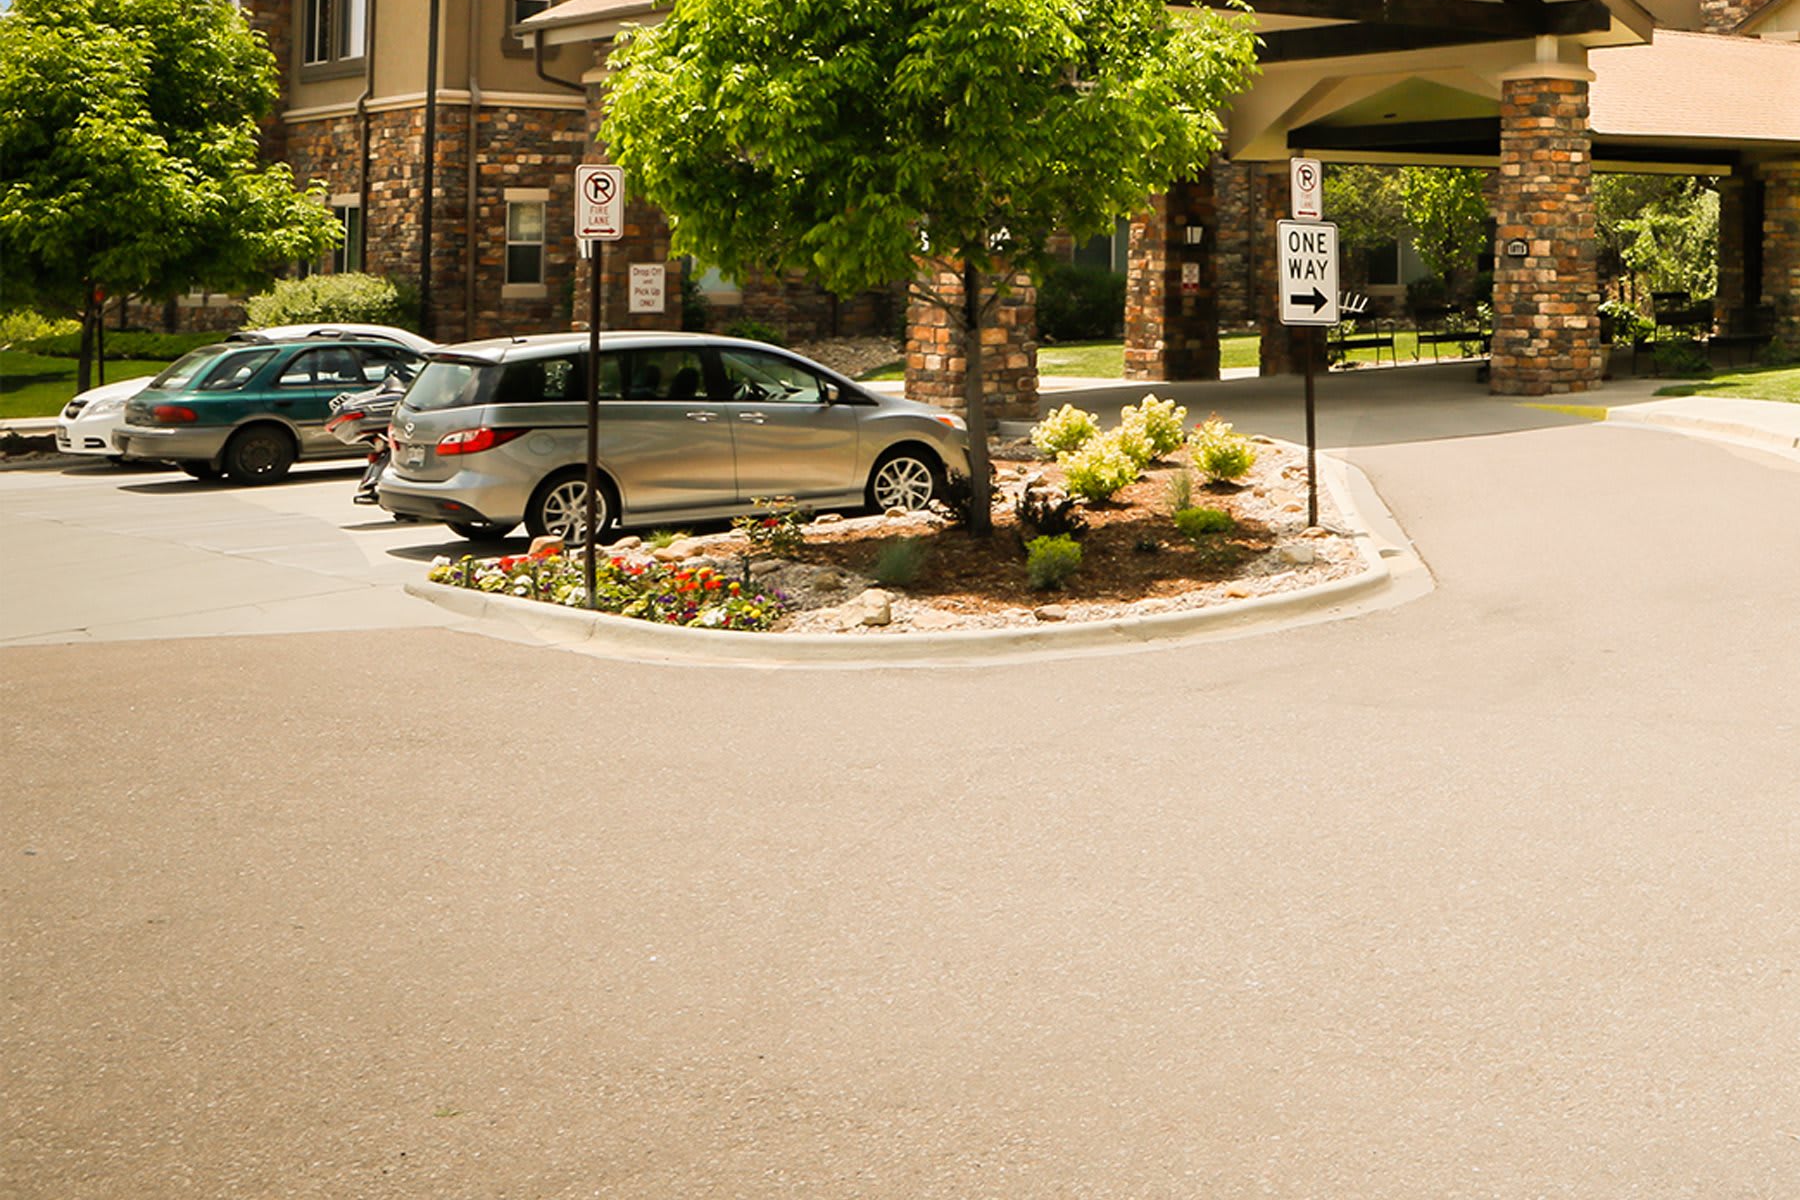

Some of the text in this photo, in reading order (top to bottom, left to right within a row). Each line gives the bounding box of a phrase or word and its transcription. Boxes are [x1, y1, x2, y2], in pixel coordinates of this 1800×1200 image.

[589, 206, 609, 215] FIRE
[588, 216, 610, 226] LANE
[1288, 231, 1328, 254] ONE
[1288, 258, 1329, 281] WAY
